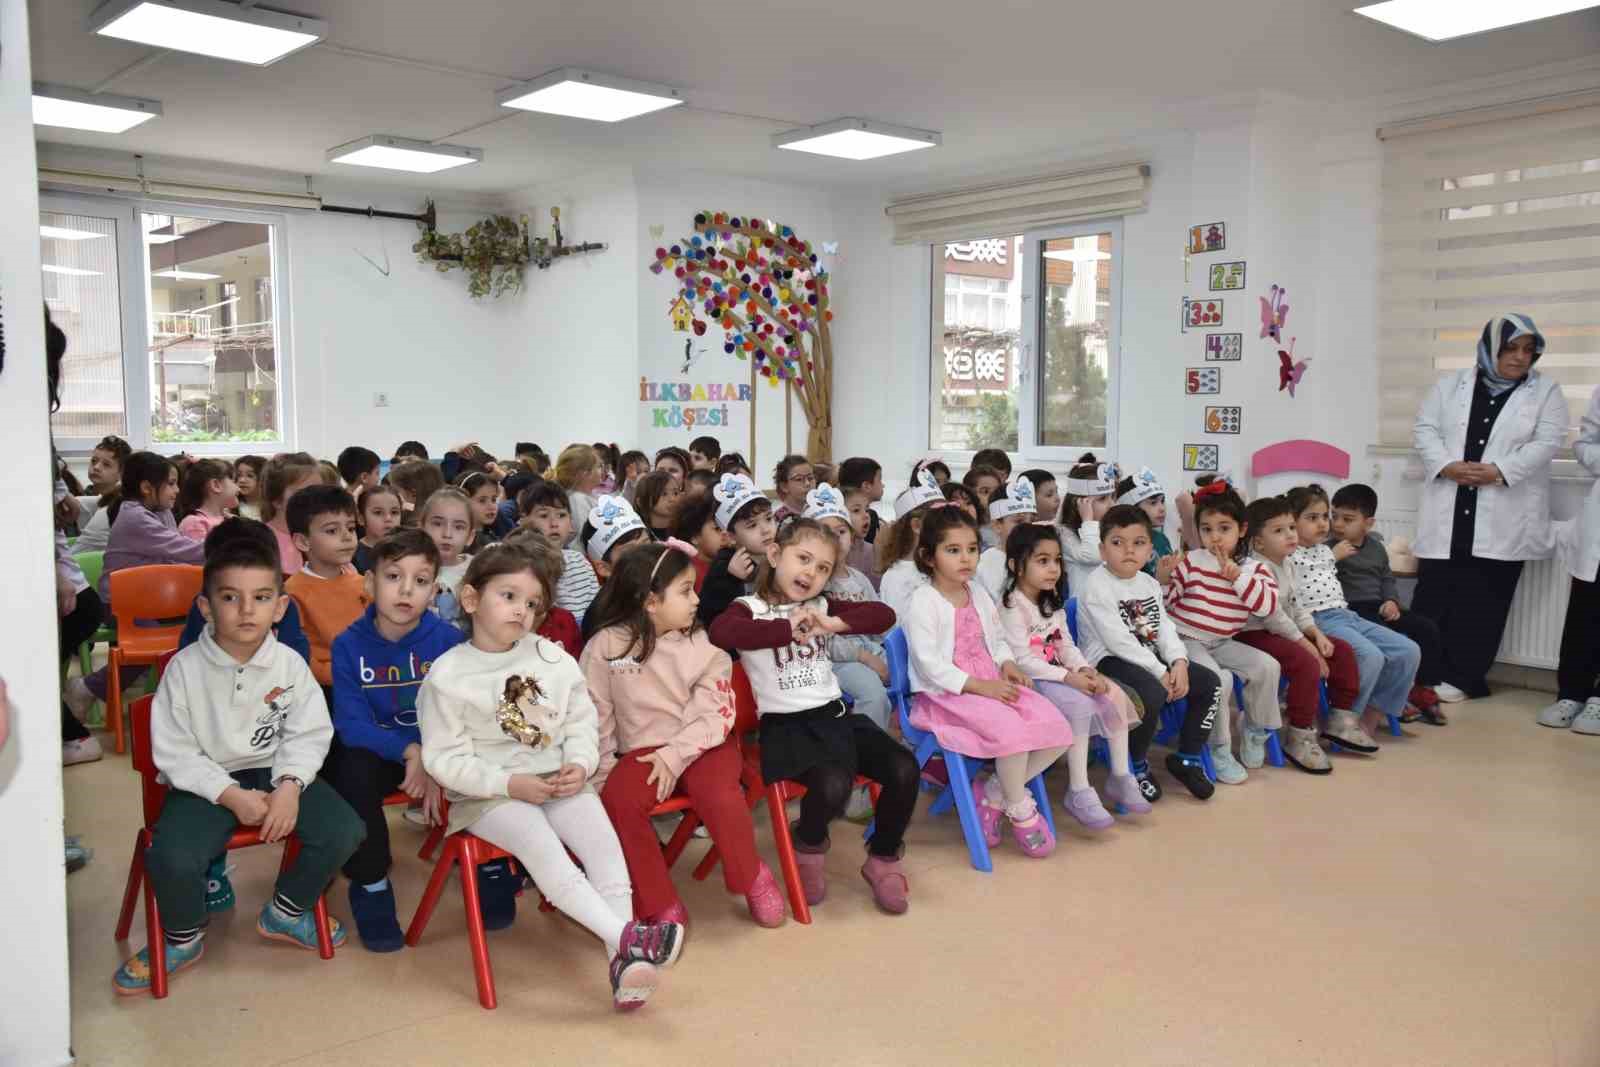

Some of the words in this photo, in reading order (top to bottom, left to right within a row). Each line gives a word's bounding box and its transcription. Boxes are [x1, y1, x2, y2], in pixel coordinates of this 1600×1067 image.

[1192, 227, 1205, 251] 1
[1213, 265, 1225, 288] 2
[1191, 302, 1202, 325] 3
[1208, 335, 1223, 358] 4
[640, 376, 752, 401] İLKBAHAR
[1188, 371, 1200, 393] 5
[652, 403, 729, 431] KÖŞESİ
[1207, 408, 1222, 432] 6
[1185, 447, 1199, 471] 7
